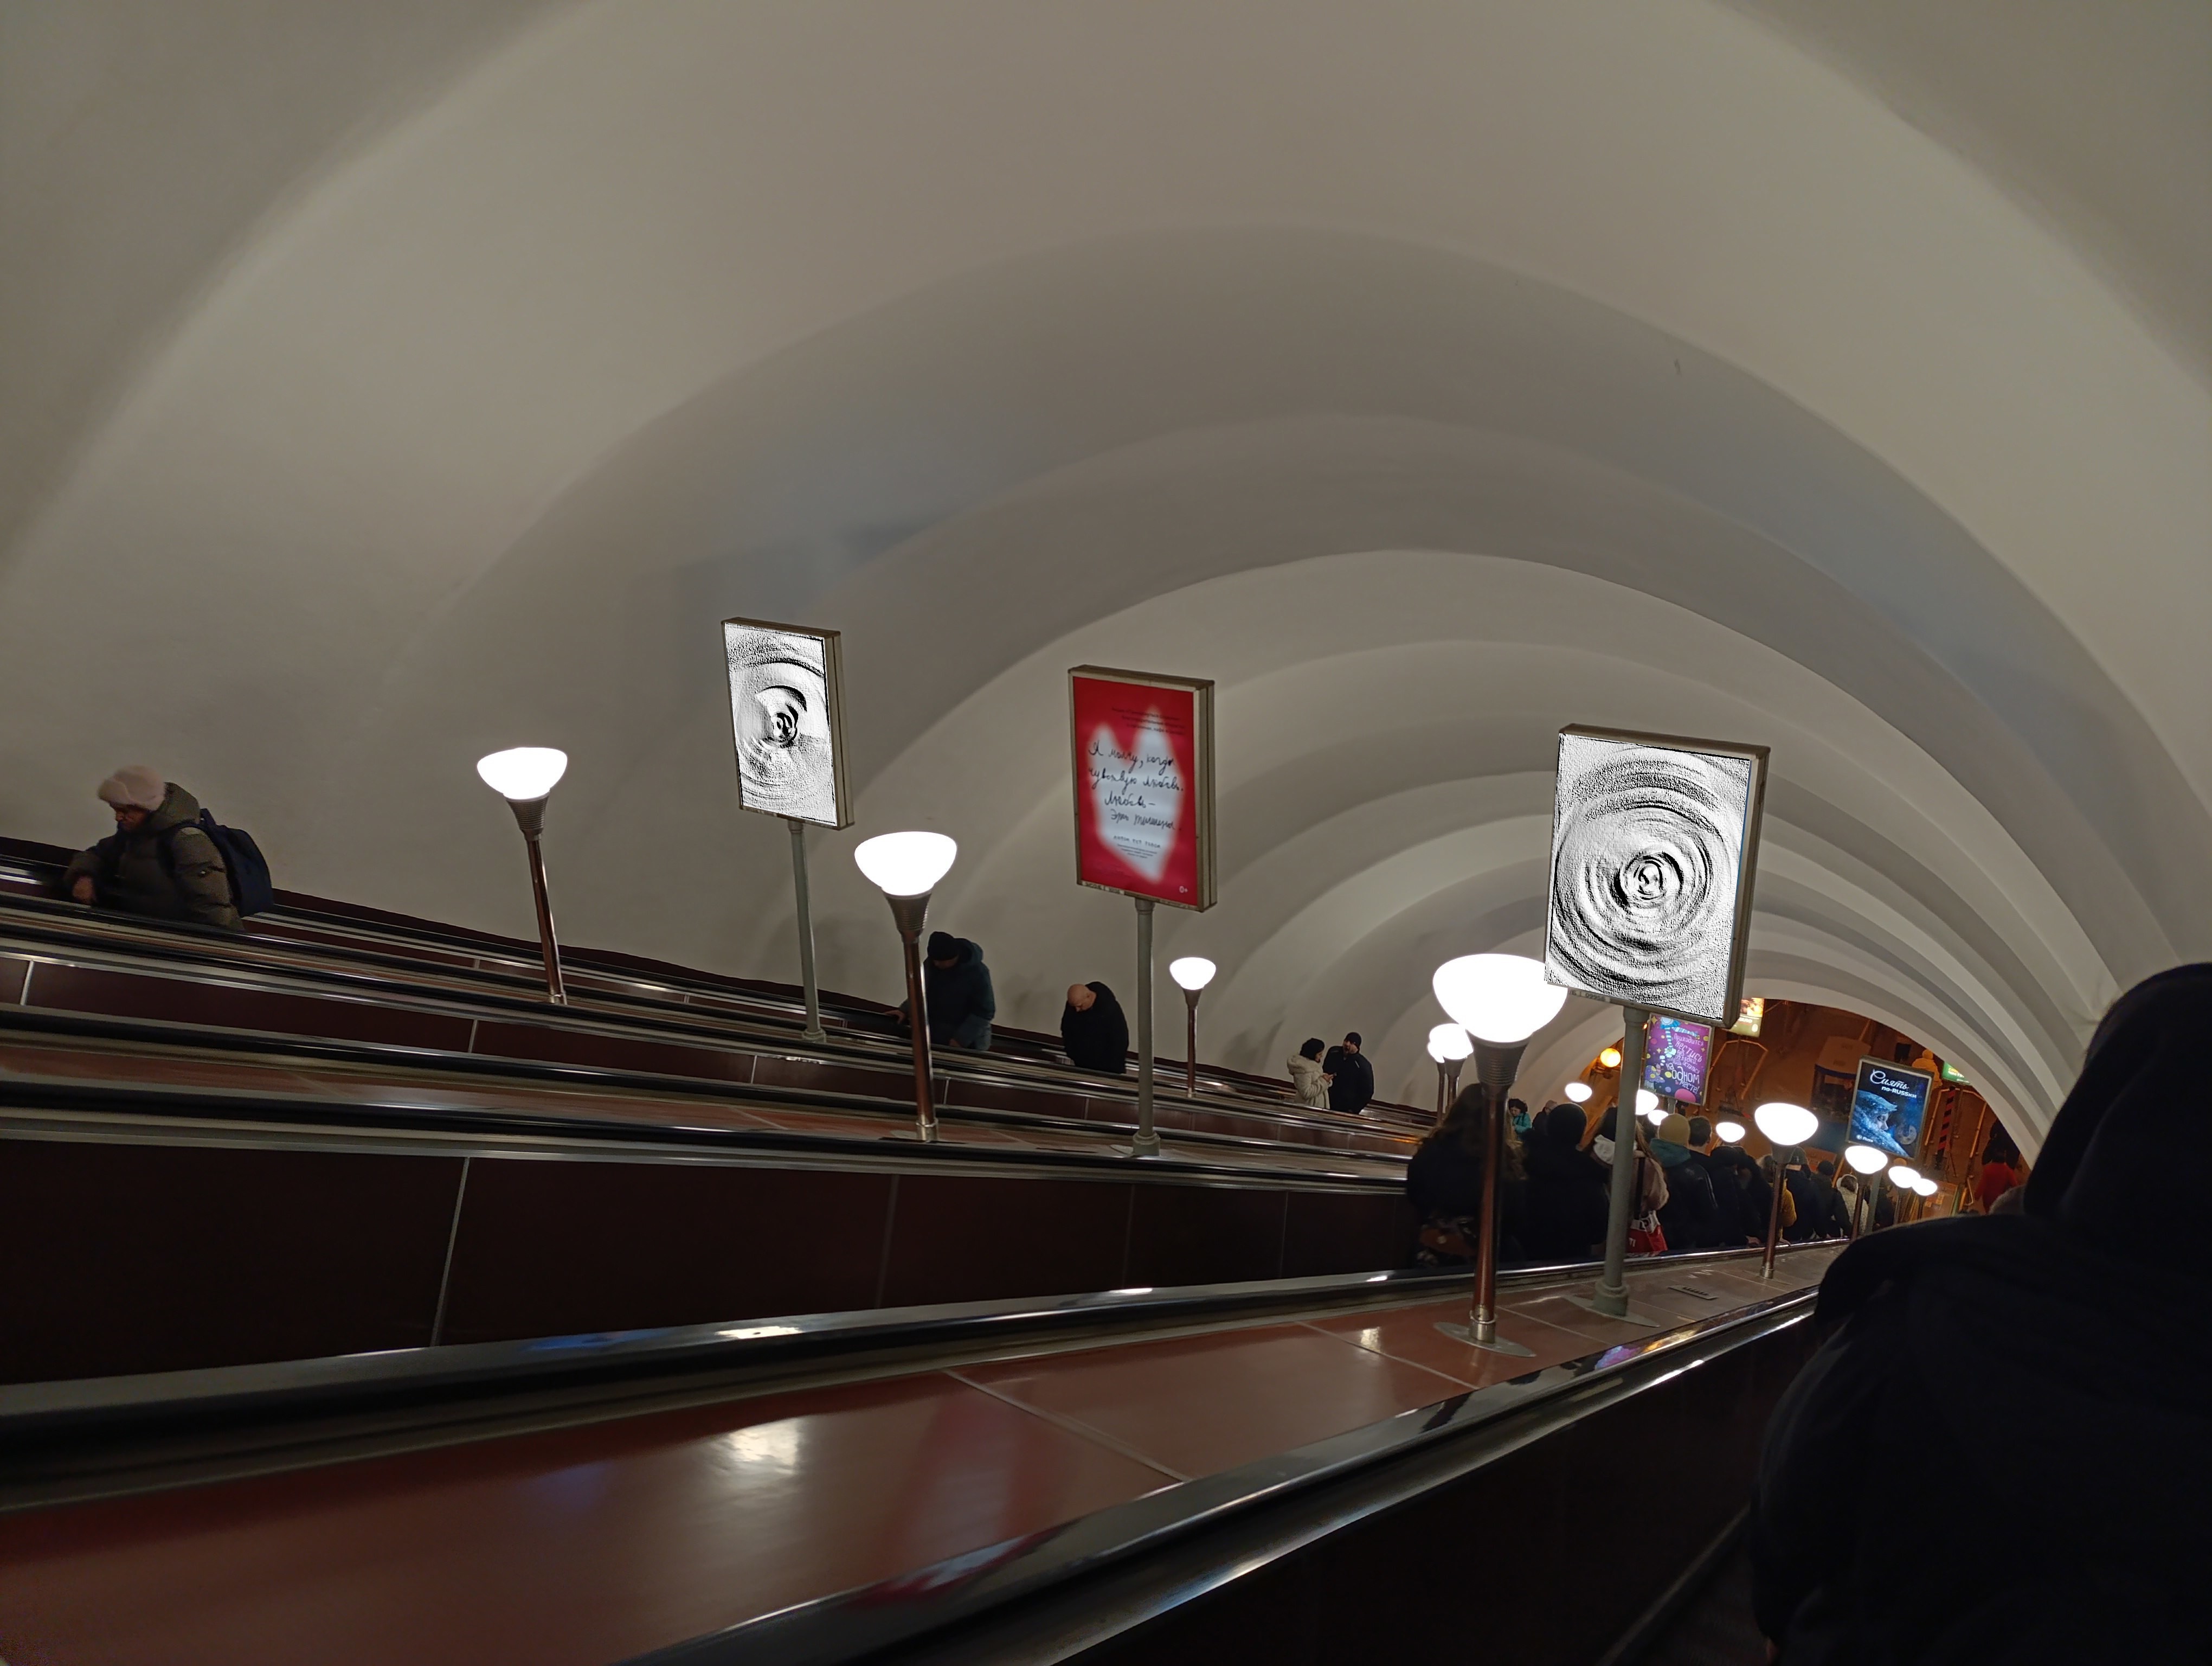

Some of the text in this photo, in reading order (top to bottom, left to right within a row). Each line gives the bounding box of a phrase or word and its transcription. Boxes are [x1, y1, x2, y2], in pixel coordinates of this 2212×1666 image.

[1089, 740, 1103, 756] Я
[1179, 886, 1188, 894] 0+
[1870, 1069, 1909, 1090] Сиять
